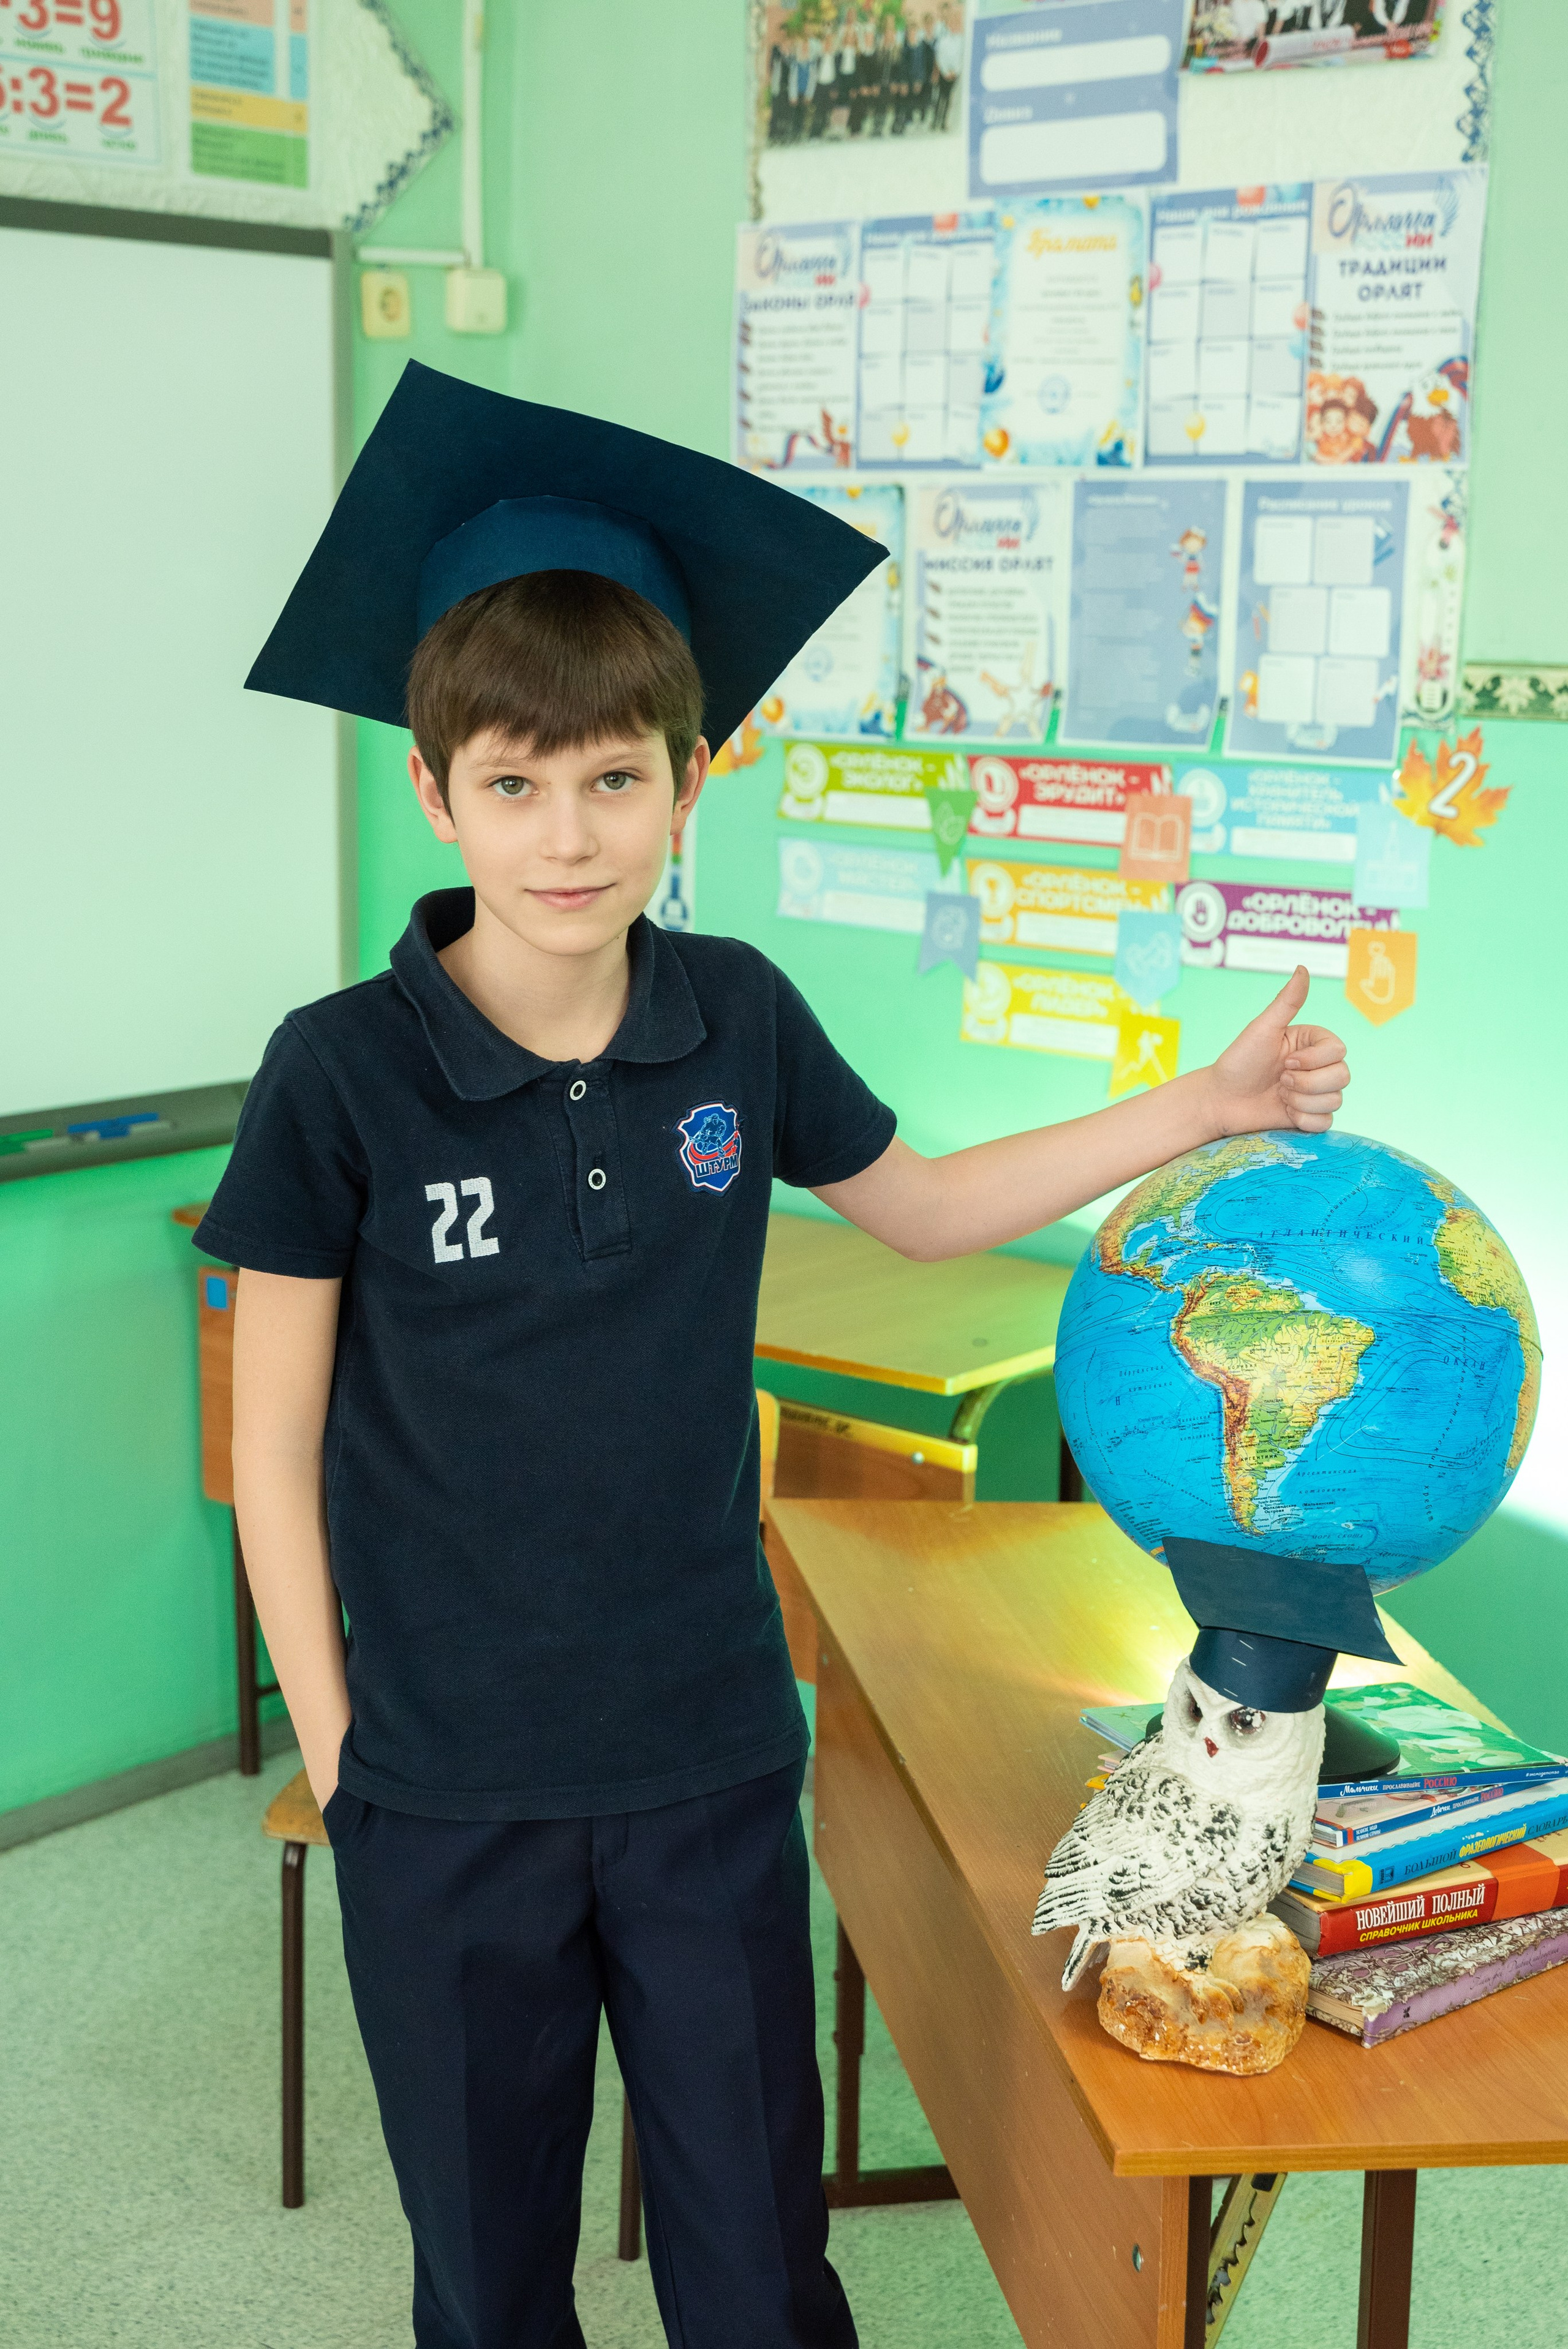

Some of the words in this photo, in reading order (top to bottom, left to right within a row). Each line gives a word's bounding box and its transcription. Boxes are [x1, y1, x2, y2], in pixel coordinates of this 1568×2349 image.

[0, 67, 133, 127] :3=2
[1340, 257, 1447, 278] ТРАДИЦИИ
[1357, 281, 1423, 301] ОРЛЯТ
[1428, 751, 1477, 819] 2
[1242, 891, 1360, 919] «ОРЛЁНОК
[695, 1153, 738, 1178] ШТУРМ
[424, 1176, 500, 1264] 22
[1257, 1229, 1423, 1245] АТЛАНТИЧЕСКИЙ
[1444, 1354, 1485, 1371] ОКЕАН
[1340, 1785, 1378, 1797] Мальчики,
[1382, 1782, 1420, 1790] ПРОСЛАВИВШИЕ
[1424, 1776, 1457, 1789] РОССИЮ
[1452, 1797, 1479, 1809] ПРОСЛАВИВШИЕ
[1480, 1788, 1504, 1803] РОССИЮ
[1404, 1850, 1457, 1876] БОЛЬШОЙ
[1459, 1823, 1527, 1858] ФРАЗЕОЛОГИЧЕСКИЙ
[1528, 1815, 1568, 1835] СЛОВАРЬ
[1355, 1895, 1425, 1931] НОВЕЙШИЙ
[1432, 1883, 1485, 1914] ПОЛНЫЙ
[1360, 1921, 1421, 1942] СПРАВОЧНИК
[1422, 1909, 1478, 1929] ШКОЛЬНИКА
